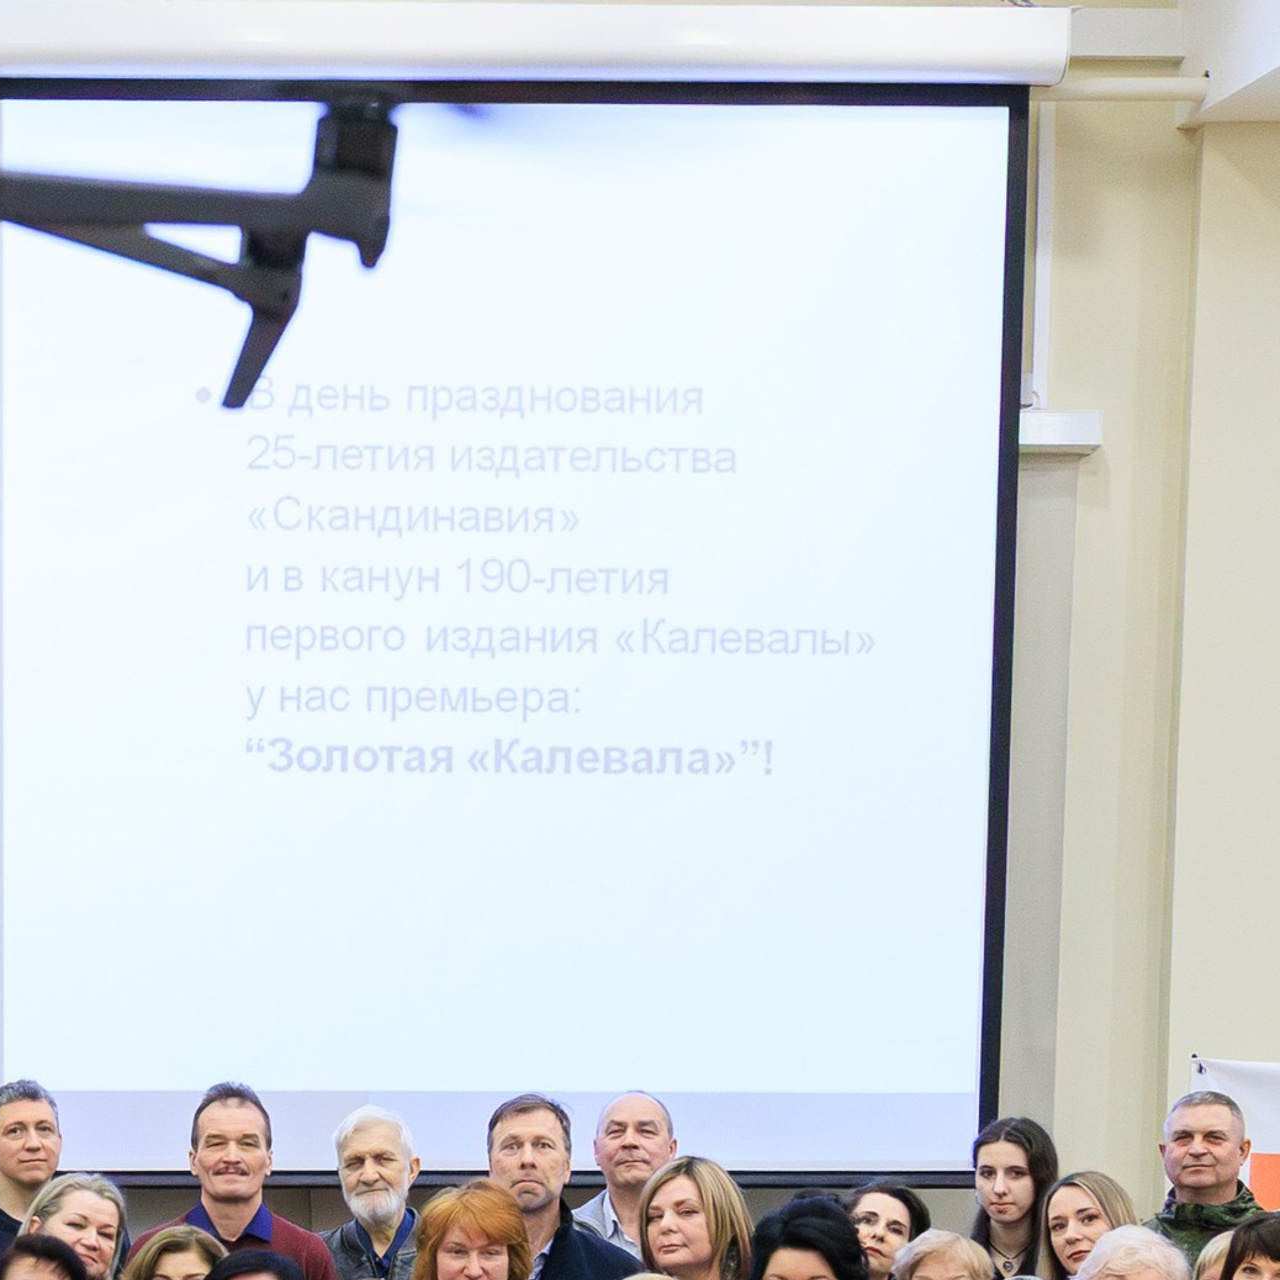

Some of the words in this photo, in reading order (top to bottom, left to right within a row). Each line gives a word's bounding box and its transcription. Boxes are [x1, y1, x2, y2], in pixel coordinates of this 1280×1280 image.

[250, 375, 275, 410] В
[286, 383, 392, 419] день
[406, 384, 704, 423] празднования
[246, 432, 436, 473] 25-летия
[449, 444, 738, 480] издательства
[247, 494, 580, 540] «Скандинавия»
[245, 564, 270, 593] и
[283, 565, 304, 593] в
[320, 565, 441, 603] канун
[457, 556, 670, 596] 190-летия
[245, 624, 408, 663] первого
[425, 625, 598, 660] издания
[614, 616, 877, 657] «Калевалы»
[245, 685, 266, 723] у
[279, 685, 351, 713] нас
[365, 685, 581, 725] премьера:
[244, 736, 455, 775] “Золотая
[467, 737, 774, 776] «Калевала»”!
